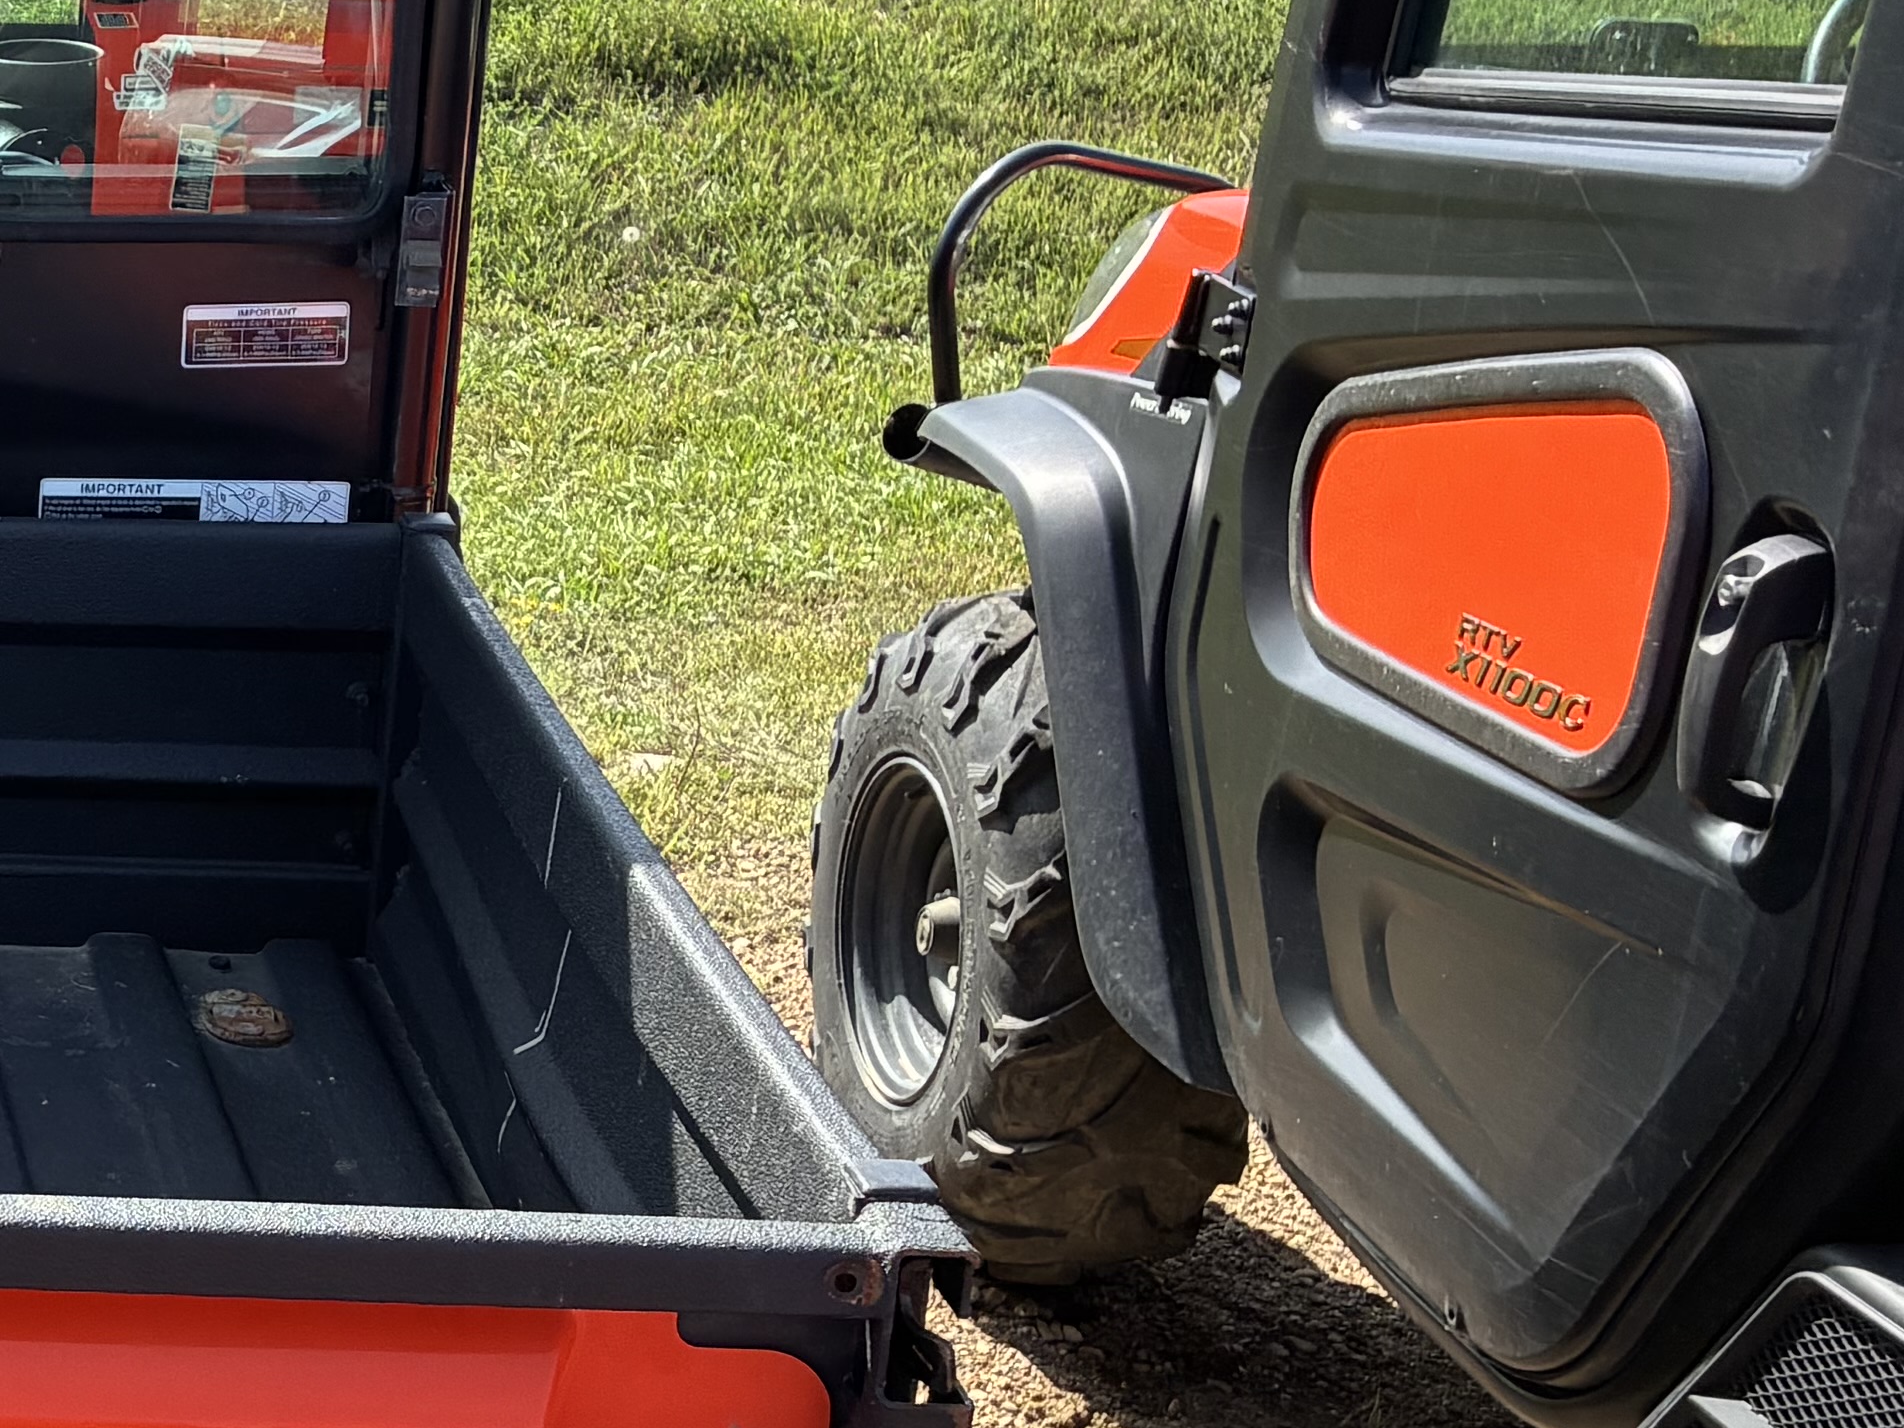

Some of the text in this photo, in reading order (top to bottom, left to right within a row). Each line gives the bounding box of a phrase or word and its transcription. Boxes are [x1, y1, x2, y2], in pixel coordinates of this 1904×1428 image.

[237, 307, 298, 318] IMPORTANT
[80, 483, 165, 495] IMPORTANT
[1457, 612, 1523, 659] RTV
[1446, 640, 1592, 732] X1100C
